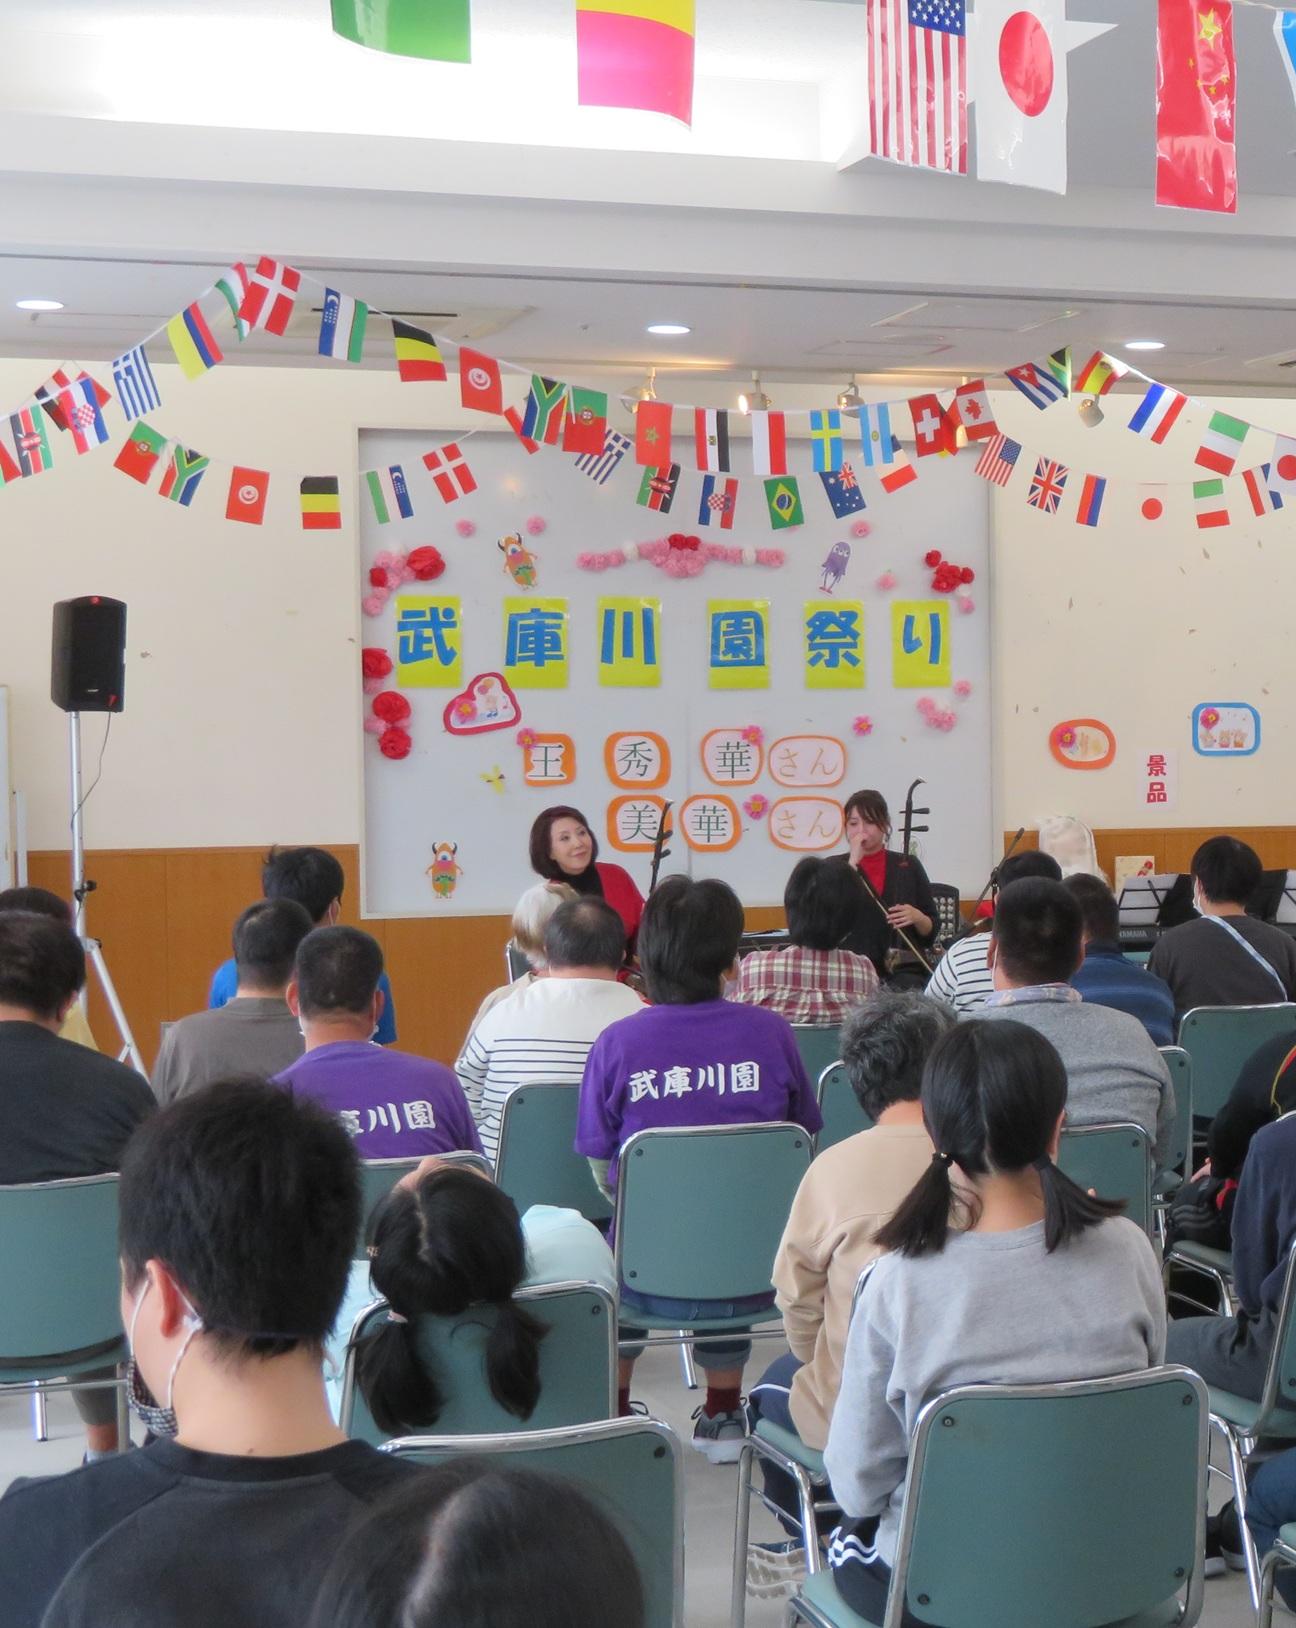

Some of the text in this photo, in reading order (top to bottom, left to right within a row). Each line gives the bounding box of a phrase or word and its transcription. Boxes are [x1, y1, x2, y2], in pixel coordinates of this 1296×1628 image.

[397, 606, 942, 669] 武庫川園祭り
[1146, 754, 1167, 804] 景品
[628, 1060, 760, 1103] 武庫川園
